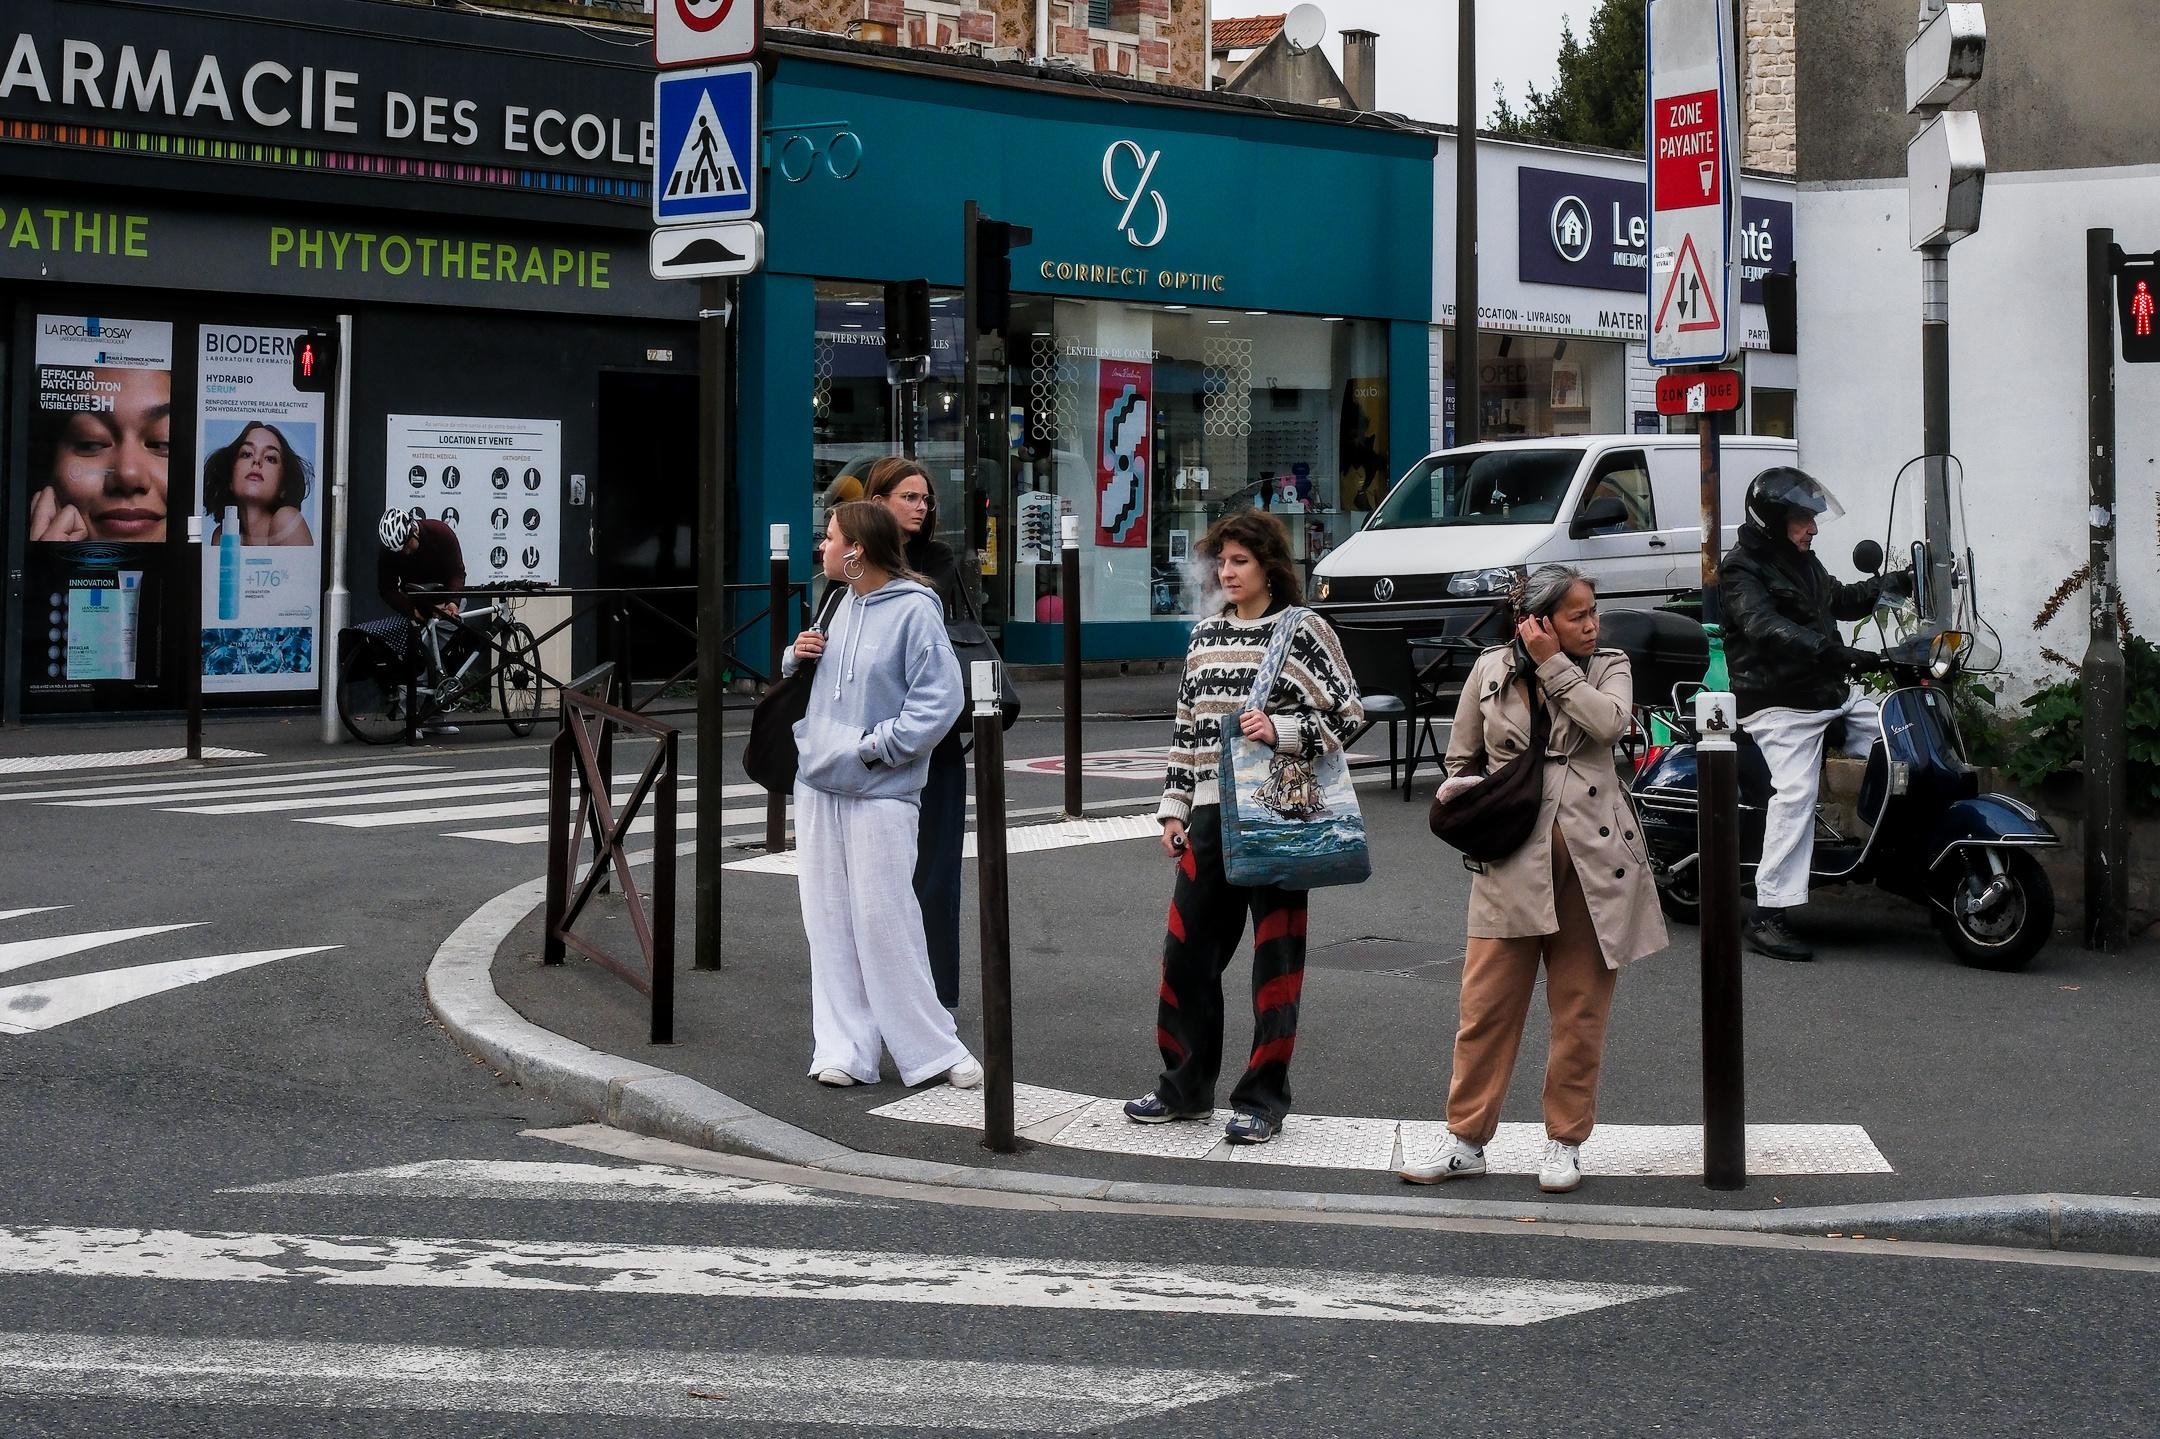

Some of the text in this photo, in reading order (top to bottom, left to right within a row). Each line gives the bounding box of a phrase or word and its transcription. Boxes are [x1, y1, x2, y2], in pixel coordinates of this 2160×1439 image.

[0, 33, 359, 134] ARMACIE
[386, 91, 479, 146] DES
[1670, 101, 1703, 128] ZONE
[1660, 130, 1714, 159] PAYANTE
[1612, 201, 1648, 248] Le
[271, 226, 611, 289] PHYTOTHERAPIE
[1040, 260, 1226, 292] CORRECT OPTIC
[1527, 311, 1571, 325] LIVRAISON
[45, 324, 58, 335] LA
[98, 327, 132, 339] POSAY
[831, 332, 857, 344] TIERS
[1066, 346, 1160, 360] LENTILLES DE CONTACT
[41, 368, 94, 381] EFFACLAR
[206, 374, 253, 384] HYDRABIO
[41, 379, 121, 392] PATCH BOUTON
[40, 392, 90, 403] EFFICACITÉ
[90, 395, 114, 412] 3H
[40, 401, 72, 411] VISIBLE
[439, 435, 513, 446] LOCATION ET VENTE
[69, 579, 114, 587] INNOVATION
